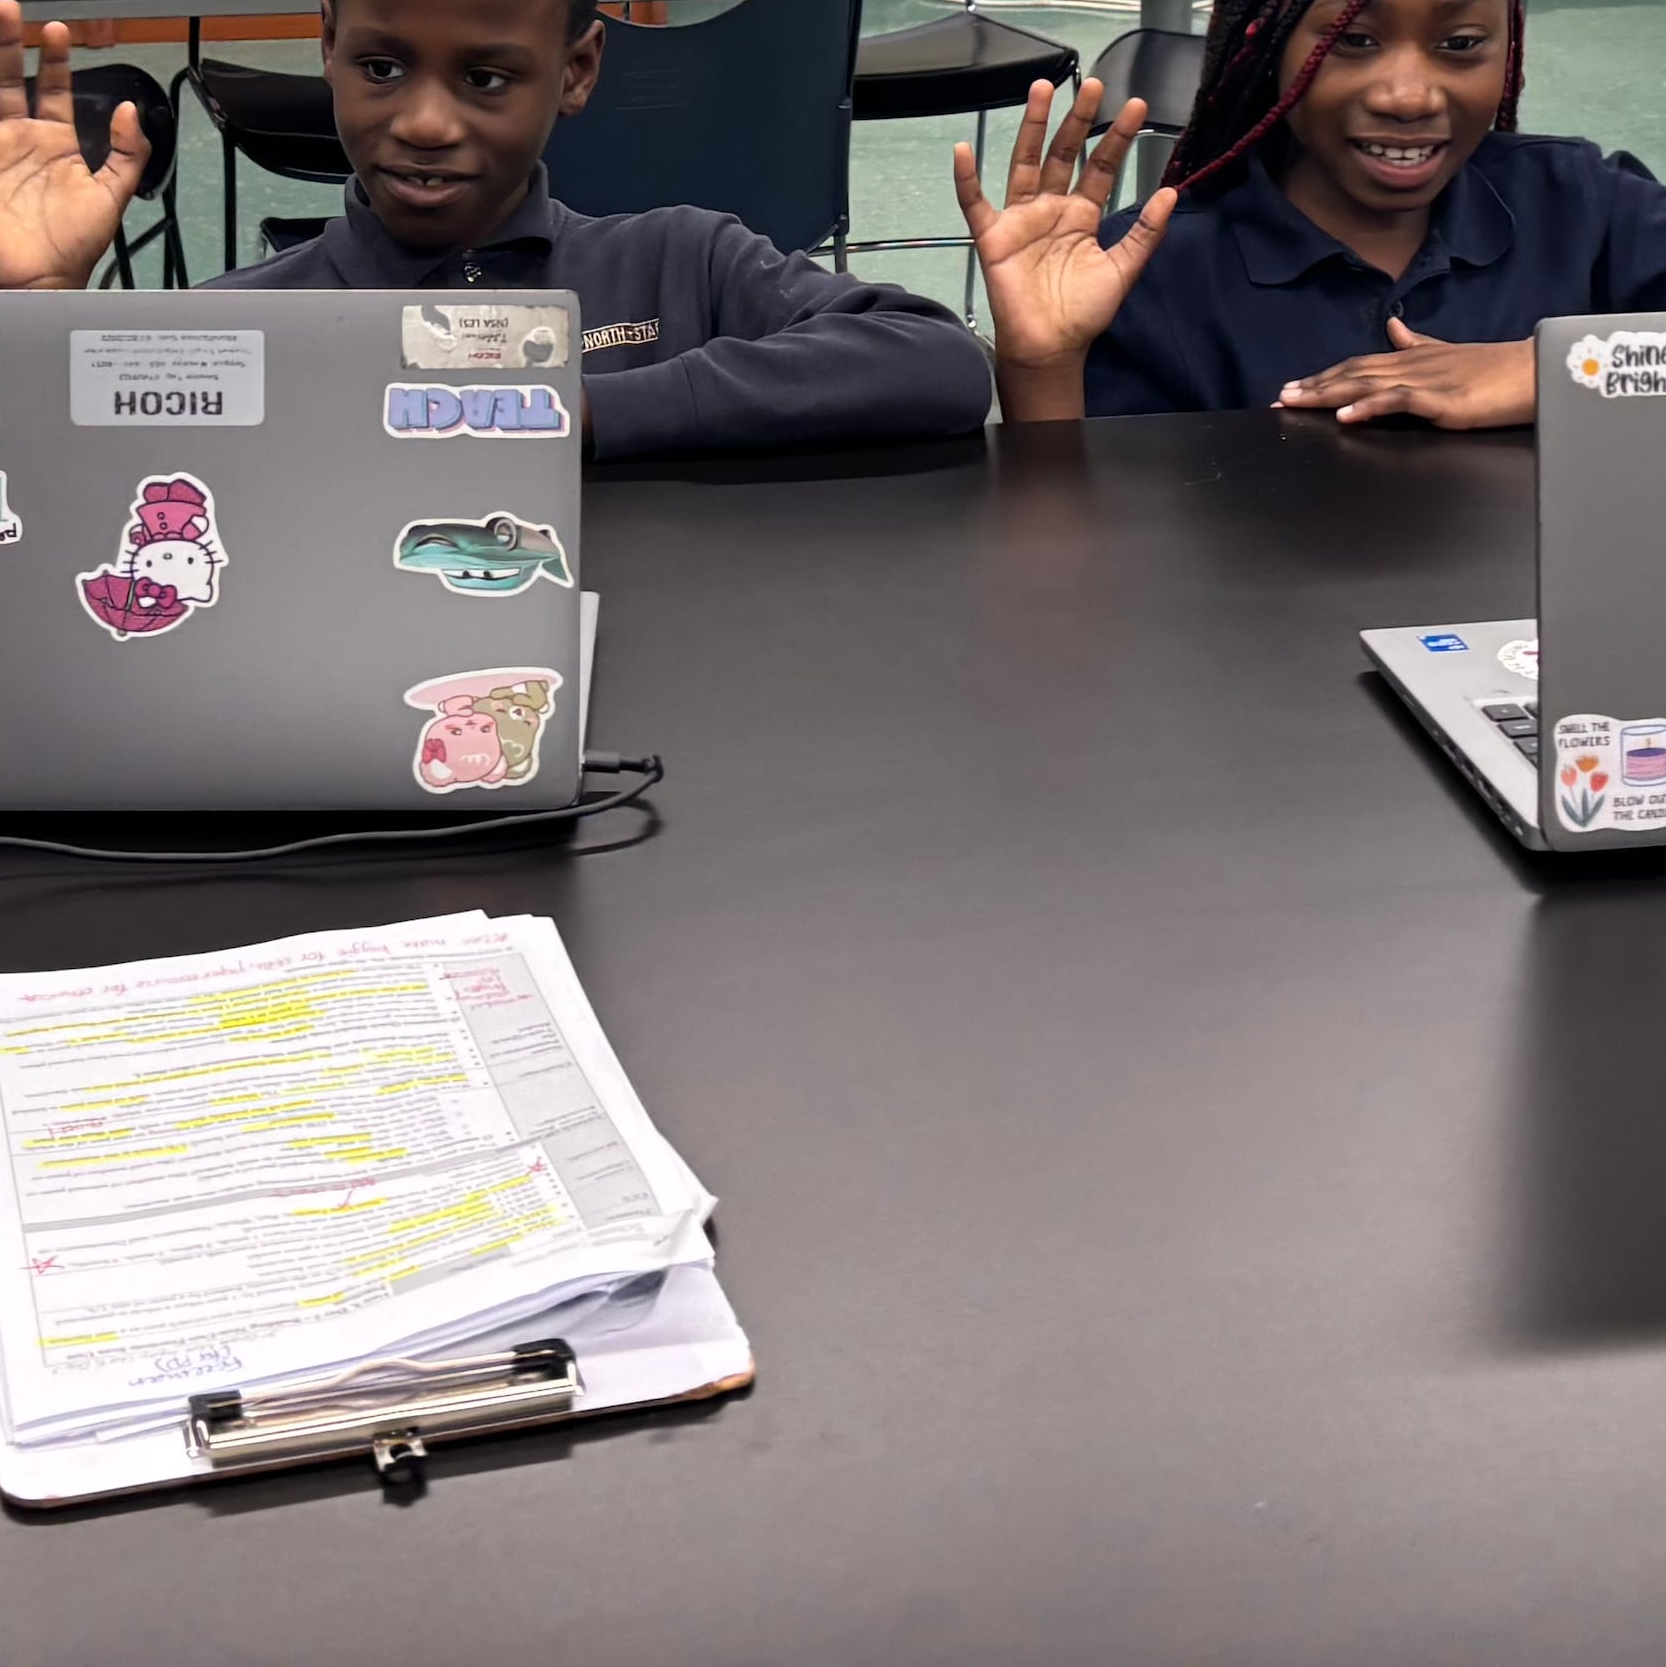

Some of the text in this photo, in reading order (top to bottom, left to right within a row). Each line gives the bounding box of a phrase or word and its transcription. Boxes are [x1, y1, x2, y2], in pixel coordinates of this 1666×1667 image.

[583, 320, 659, 350] NORTH STA
[114, 390, 223, 416] RICOH
[388, 387, 565, 434] TEACH
[1558, 722, 1611, 734] SMELL THE
[1559, 735, 1610, 748] FLOWERS
[1613, 796, 1645, 808] BLOW
[1613, 810, 1635, 821] THE
